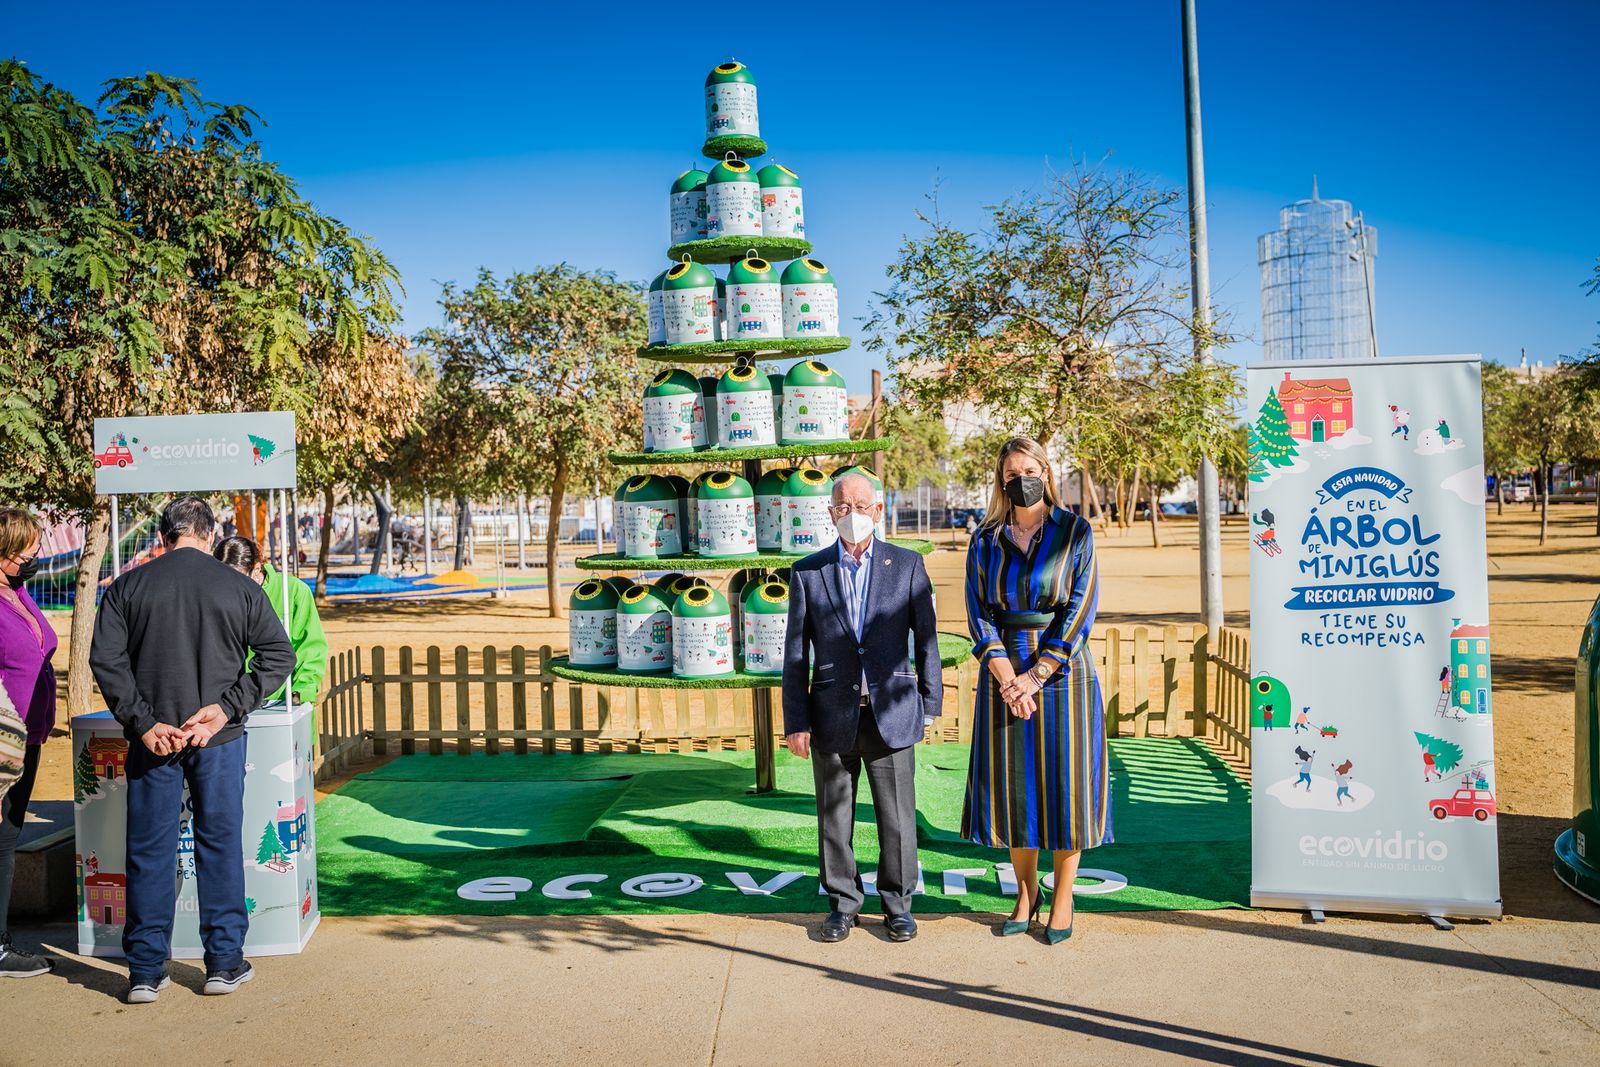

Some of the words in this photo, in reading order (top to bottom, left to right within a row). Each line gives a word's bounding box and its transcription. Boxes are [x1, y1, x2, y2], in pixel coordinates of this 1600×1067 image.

[151, 438, 240, 459] ecovidrio
[1331, 475, 1353, 492] ESTA
[1354, 473, 1398, 491] NAVIDAD
[1347, 500, 1365, 512] EN
[1369, 499, 1387, 511] EL
[1301, 507, 1441, 549] ÁRBOL
[1308, 543, 1322, 554] DE
[1299, 549, 1440, 579] MINIGLÚS
[1304, 588, 1377, 604] RECICLAR
[1380, 586, 1435, 601] VIDRIO
[1320, 613, 1377, 628] TIENE
[1386, 613, 1406, 628] SU
[1301, 631, 1425, 646] RECOMPENSA
[1299, 829, 1449, 861] ecovidrio
[1413, 863, 1446, 873] LUCRO
